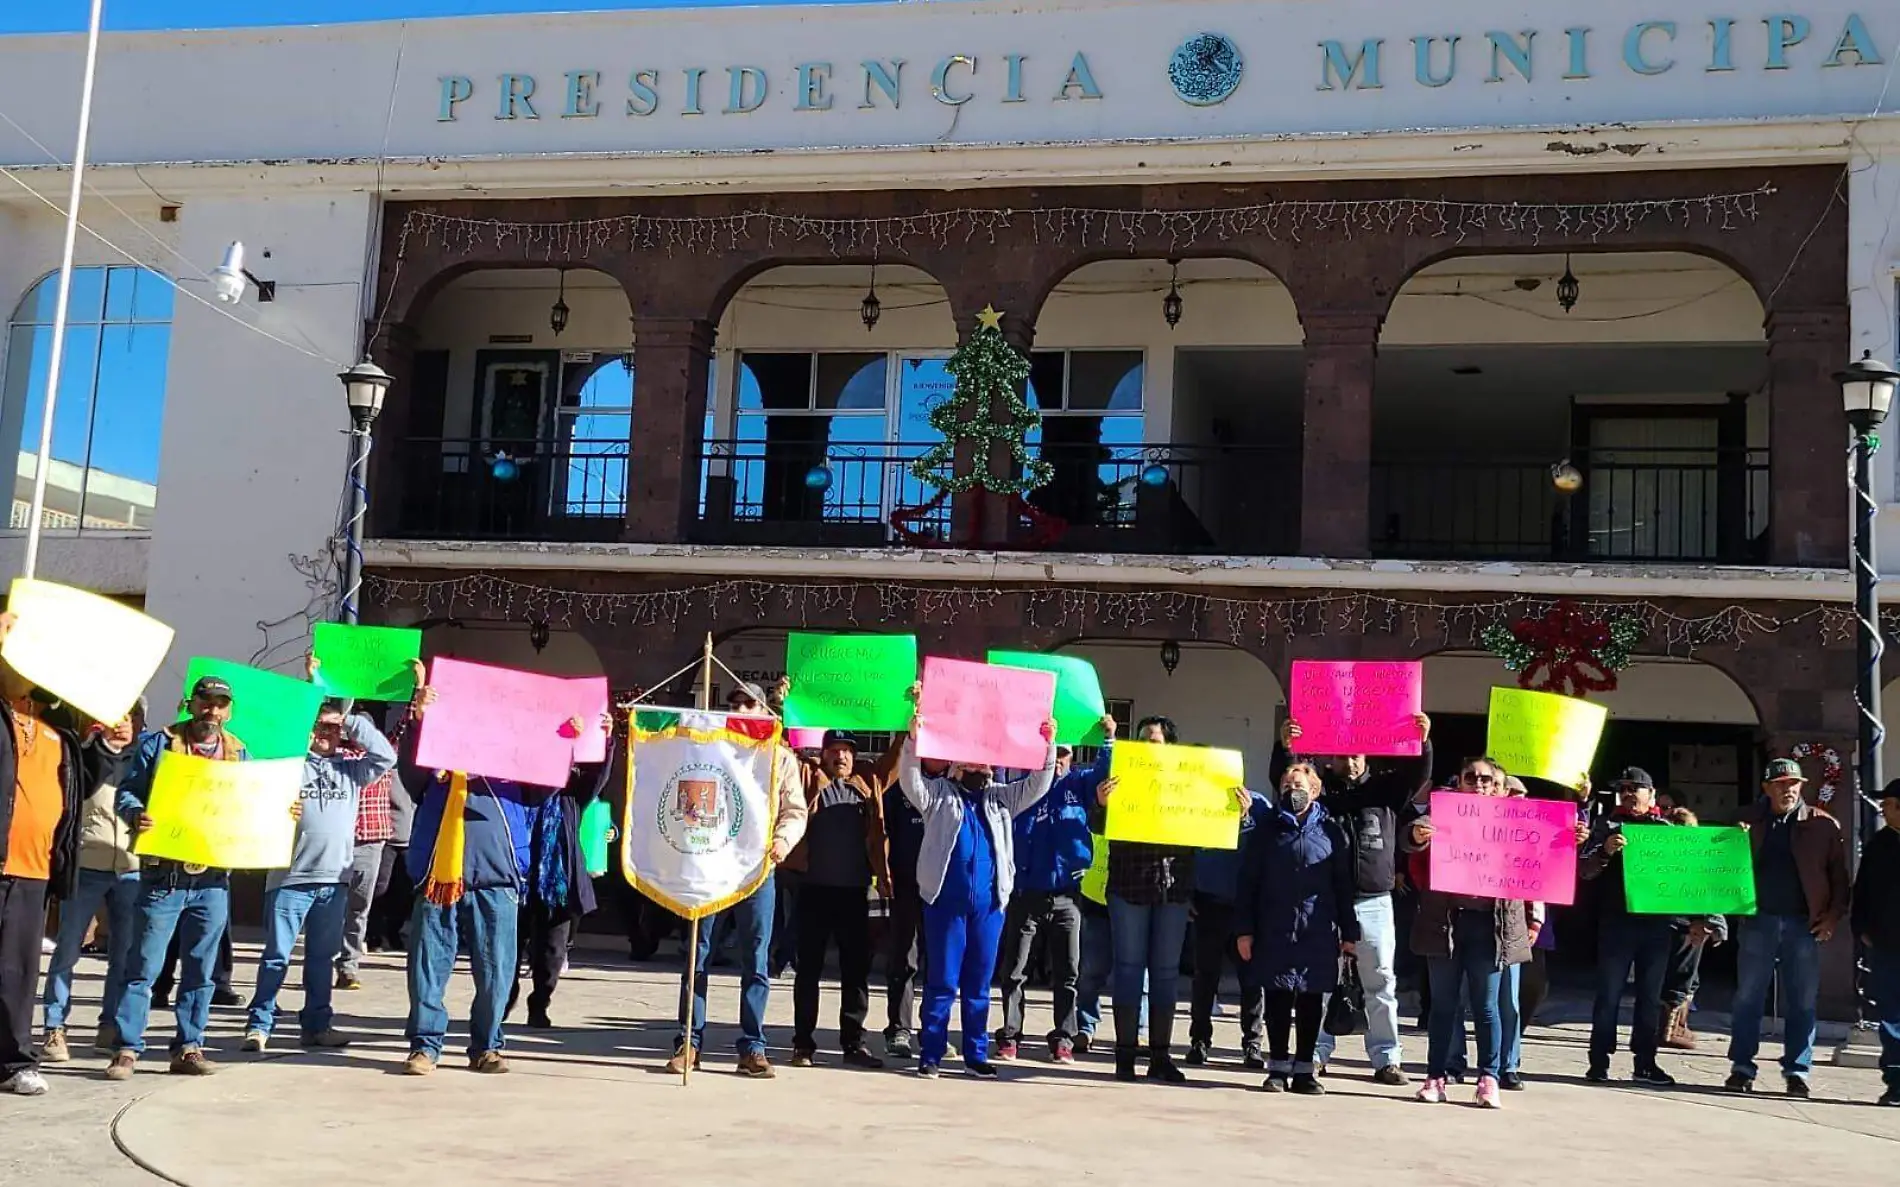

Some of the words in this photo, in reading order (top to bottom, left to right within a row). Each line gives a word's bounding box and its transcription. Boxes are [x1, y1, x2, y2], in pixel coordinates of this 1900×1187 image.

[437, 51, 1103, 122] PRESIDENCIA
[1316, 13, 1884, 92] MUNICIPA
[1457, 803, 1481, 817] UN
[1482, 825, 1541, 845] UNIDO
